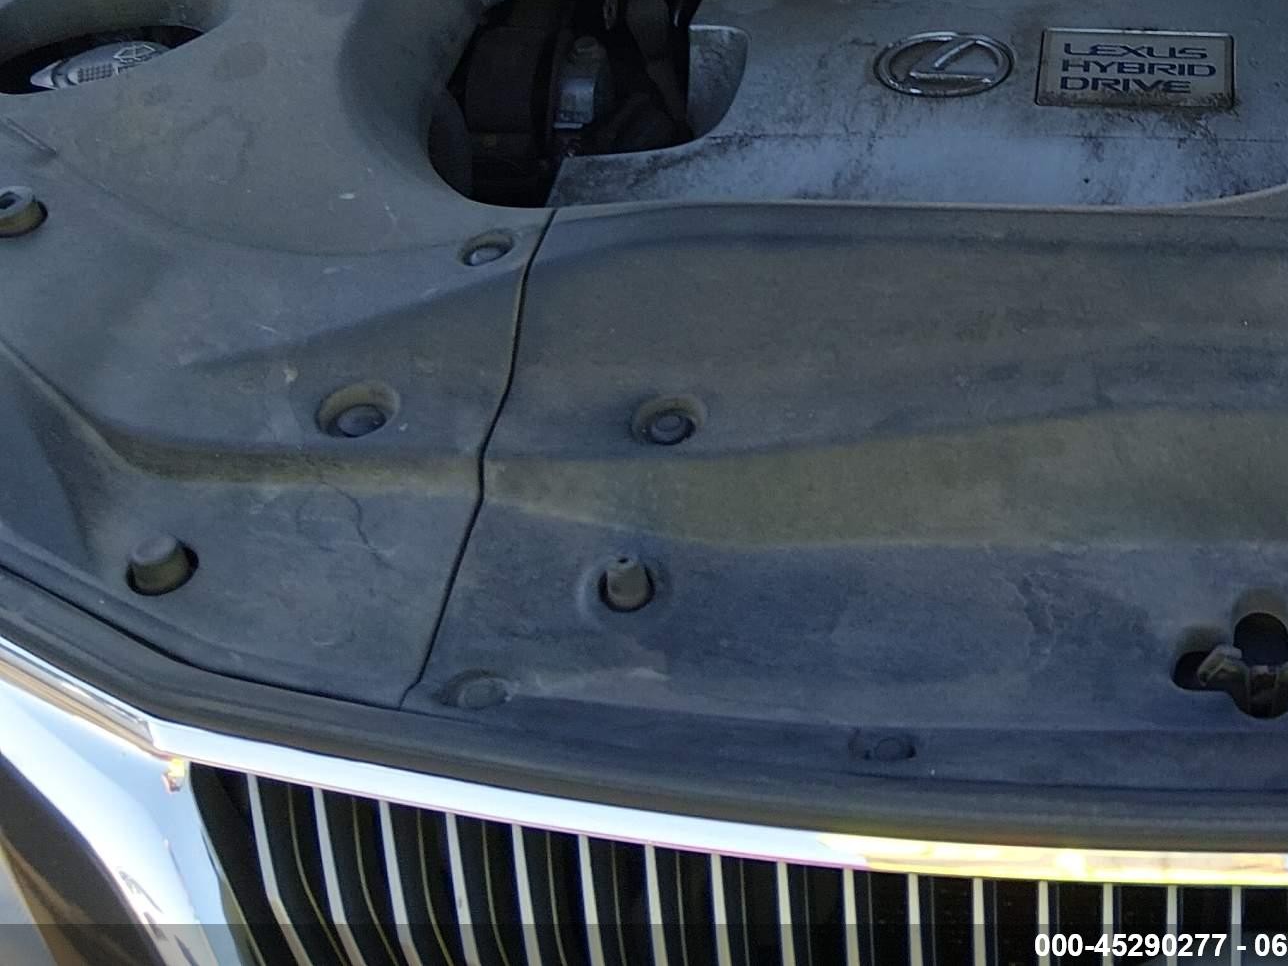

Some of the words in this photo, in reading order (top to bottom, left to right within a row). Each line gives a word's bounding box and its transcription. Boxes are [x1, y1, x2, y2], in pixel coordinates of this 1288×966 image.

[1064, 43, 1208, 60] LEXUS
[1061, 58, 1217, 77] HYBRID
[1060, 76, 1192, 94] DRIVE
